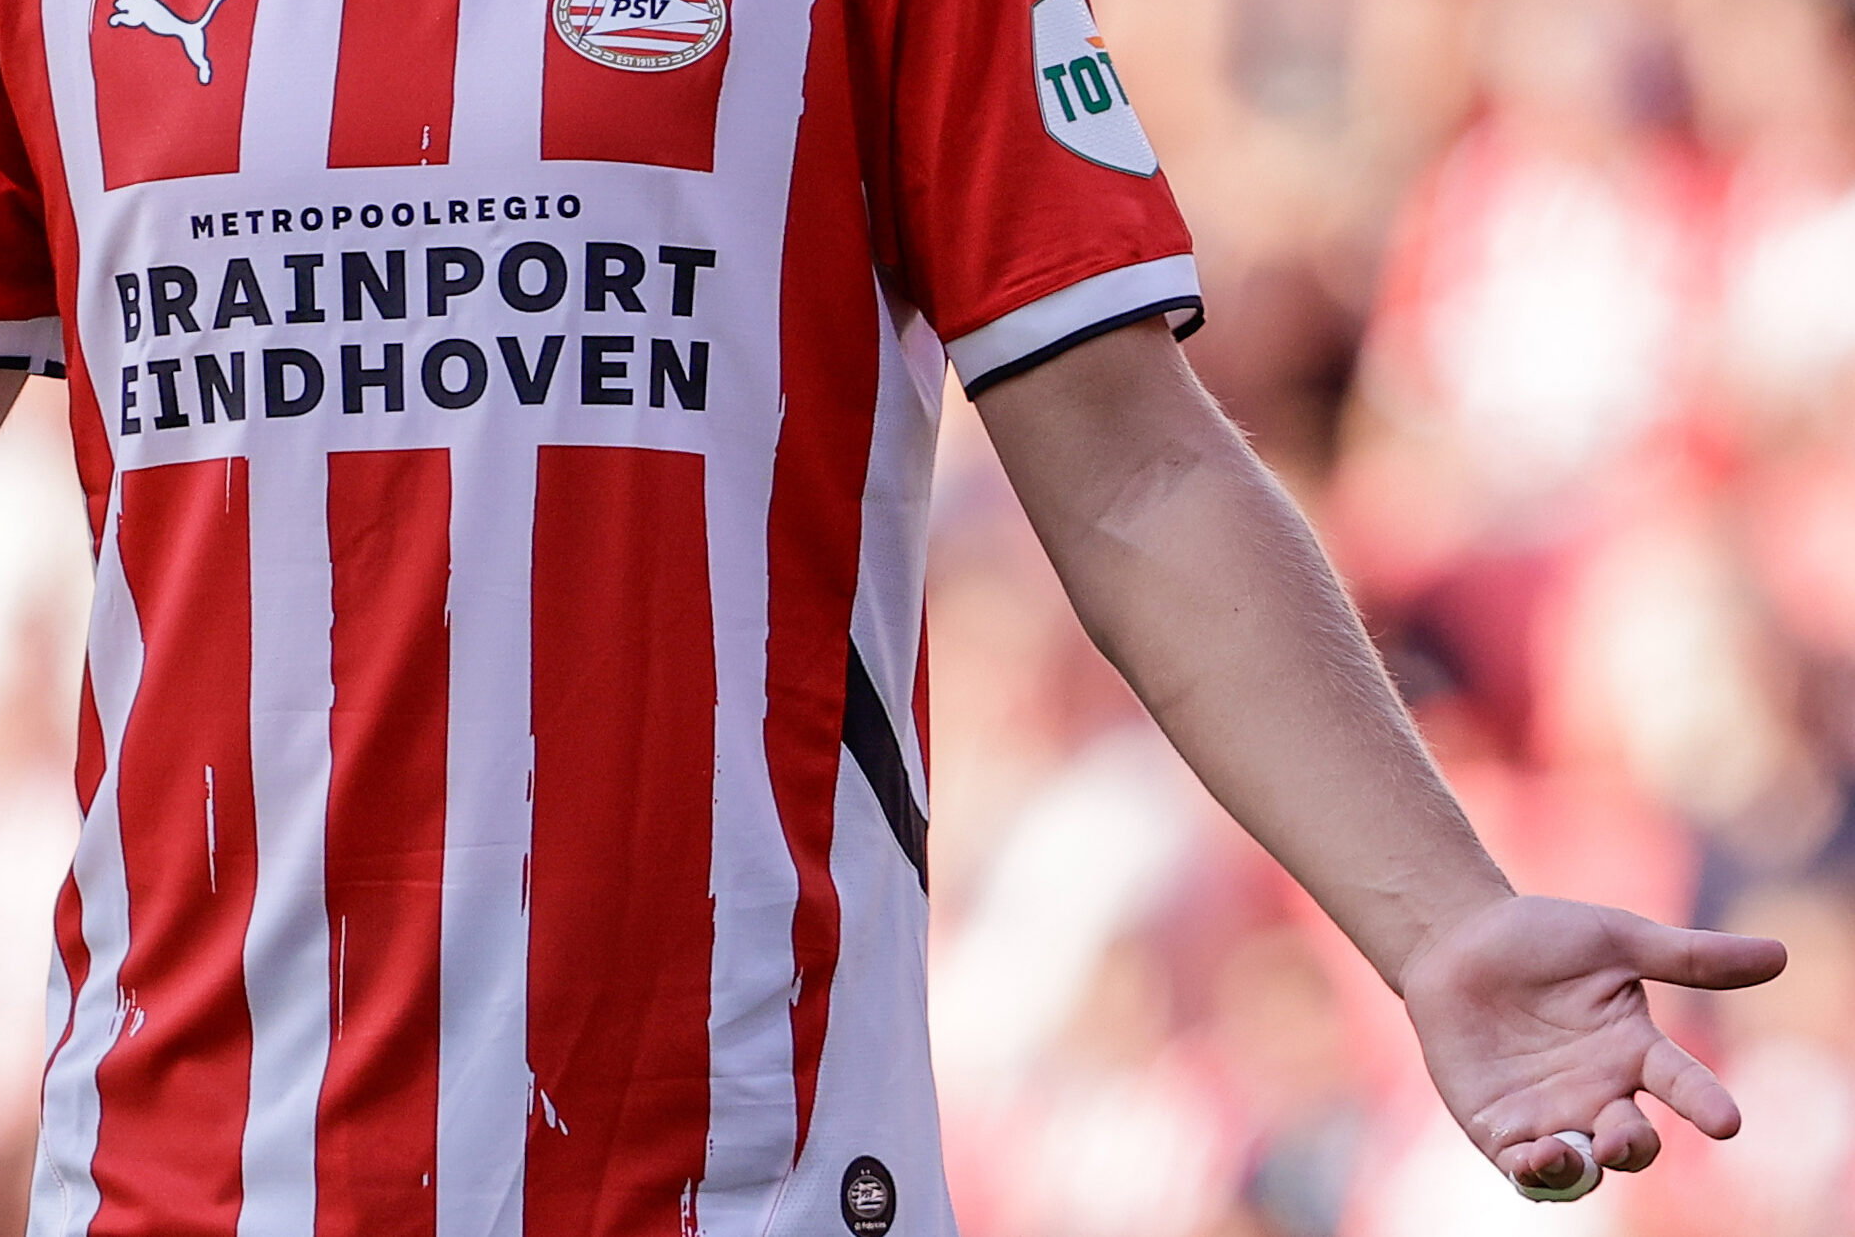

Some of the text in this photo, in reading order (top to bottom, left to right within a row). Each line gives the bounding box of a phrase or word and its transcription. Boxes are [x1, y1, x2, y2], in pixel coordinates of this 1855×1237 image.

[616, 55, 634, 66] EST
[191, 194, 582, 239] METROPOOLREGIO
[115, 241, 717, 343] BRAINPORT
[120, 334, 710, 436] EINDHOVEN
